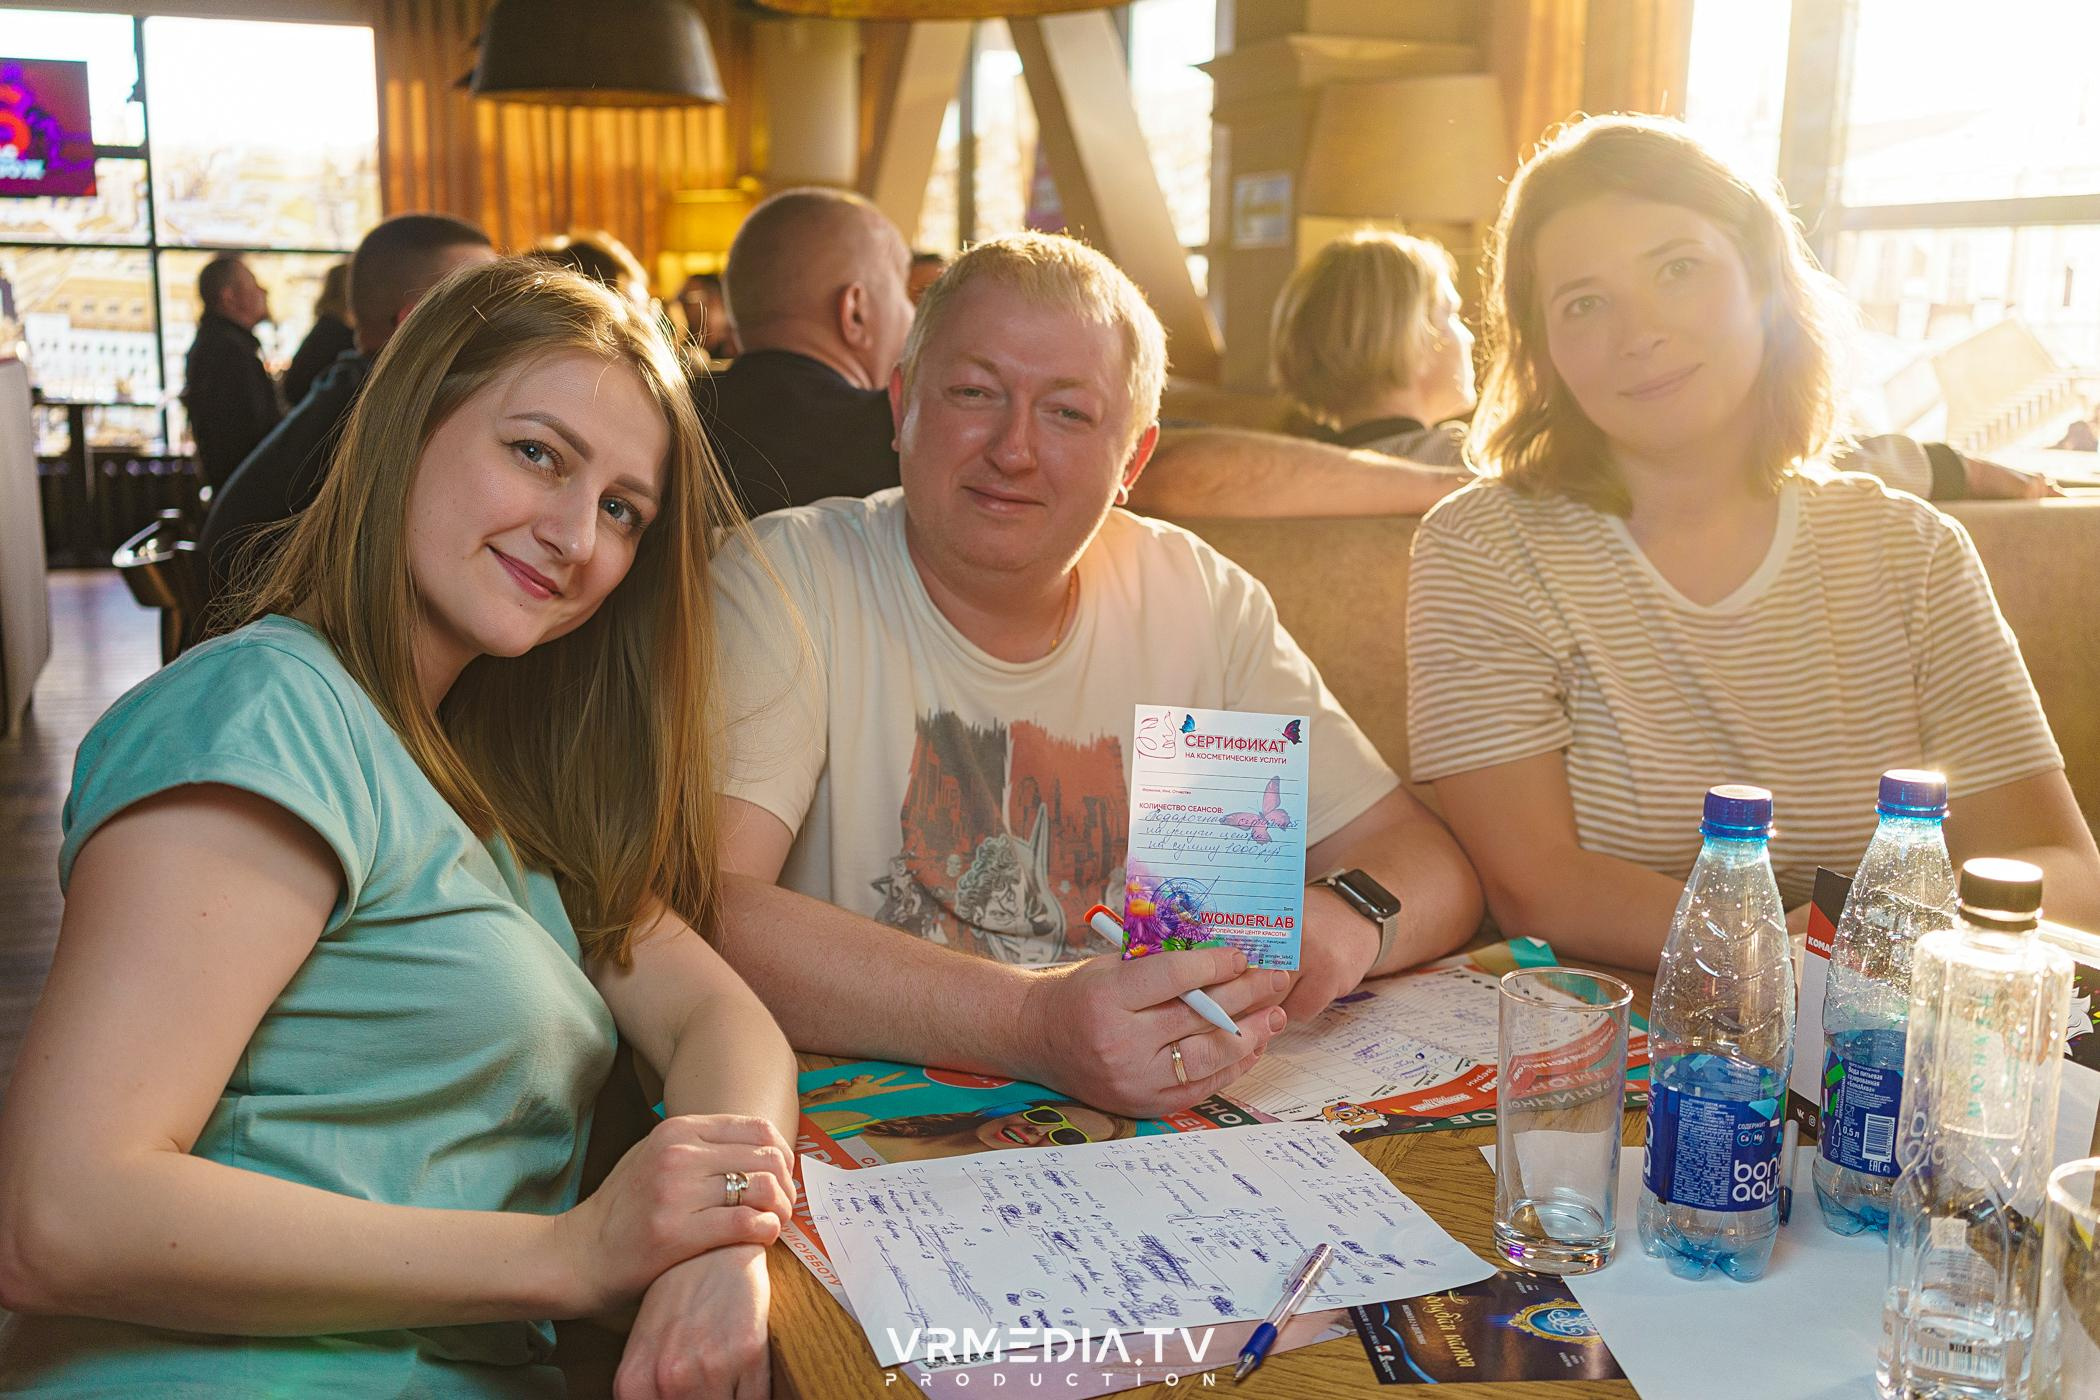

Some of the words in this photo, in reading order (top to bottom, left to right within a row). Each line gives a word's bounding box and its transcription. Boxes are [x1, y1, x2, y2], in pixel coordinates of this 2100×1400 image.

[1184, 734, 1288, 753] СЕРТИФИКАТ
[1185, 752, 1196, 760] НА
[1196, 753, 1258, 763] КОСМЕТИЧЕСКИЕ
[1259, 757, 1287, 765] УСЛУГИ
[1139, 803, 1187, 812] КОЛИЧЕСТВО
[1188, 805, 1224, 814] СЕАНСОВ:
[1200, 911, 1295, 929] WONDERLAB
[1807, 936, 1832, 953] КОМА
[1737, 1121, 1766, 1130] СОДЕРЖИТ
[1842, 1125, 1854, 1136] 0,5
[1740, 1134, 1749, 1142] Ca
[1753, 1134, 1763, 1143] Mg
[793, 1240, 843, 1287] СУББОТУ
